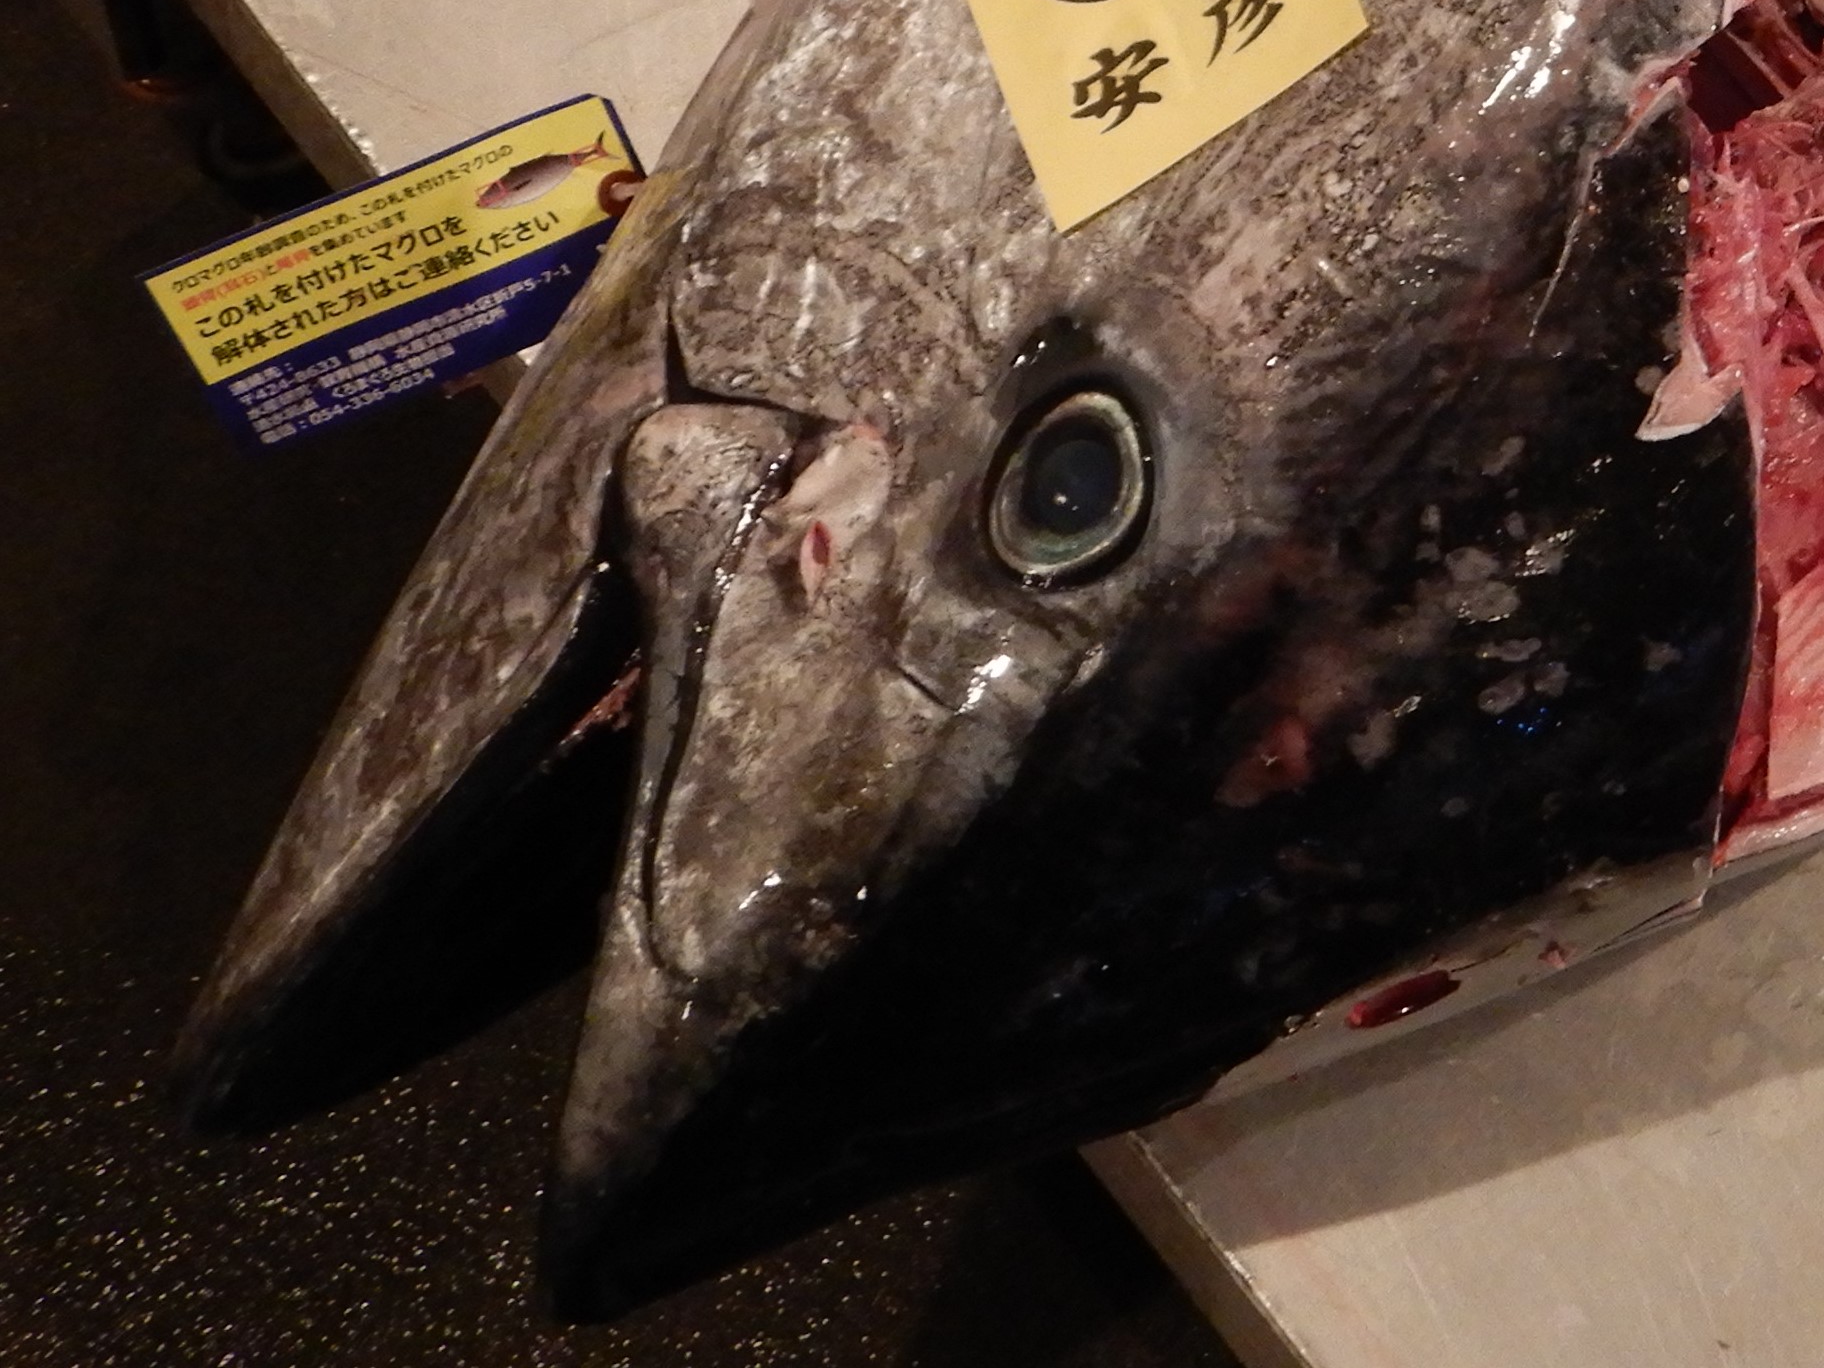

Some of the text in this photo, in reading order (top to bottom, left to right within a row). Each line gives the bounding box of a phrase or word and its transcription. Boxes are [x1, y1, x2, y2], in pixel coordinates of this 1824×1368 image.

[193, 212, 468, 339] この札を付けたマグロを
[209, 208, 562, 367] 解体された方はご連絡ください
